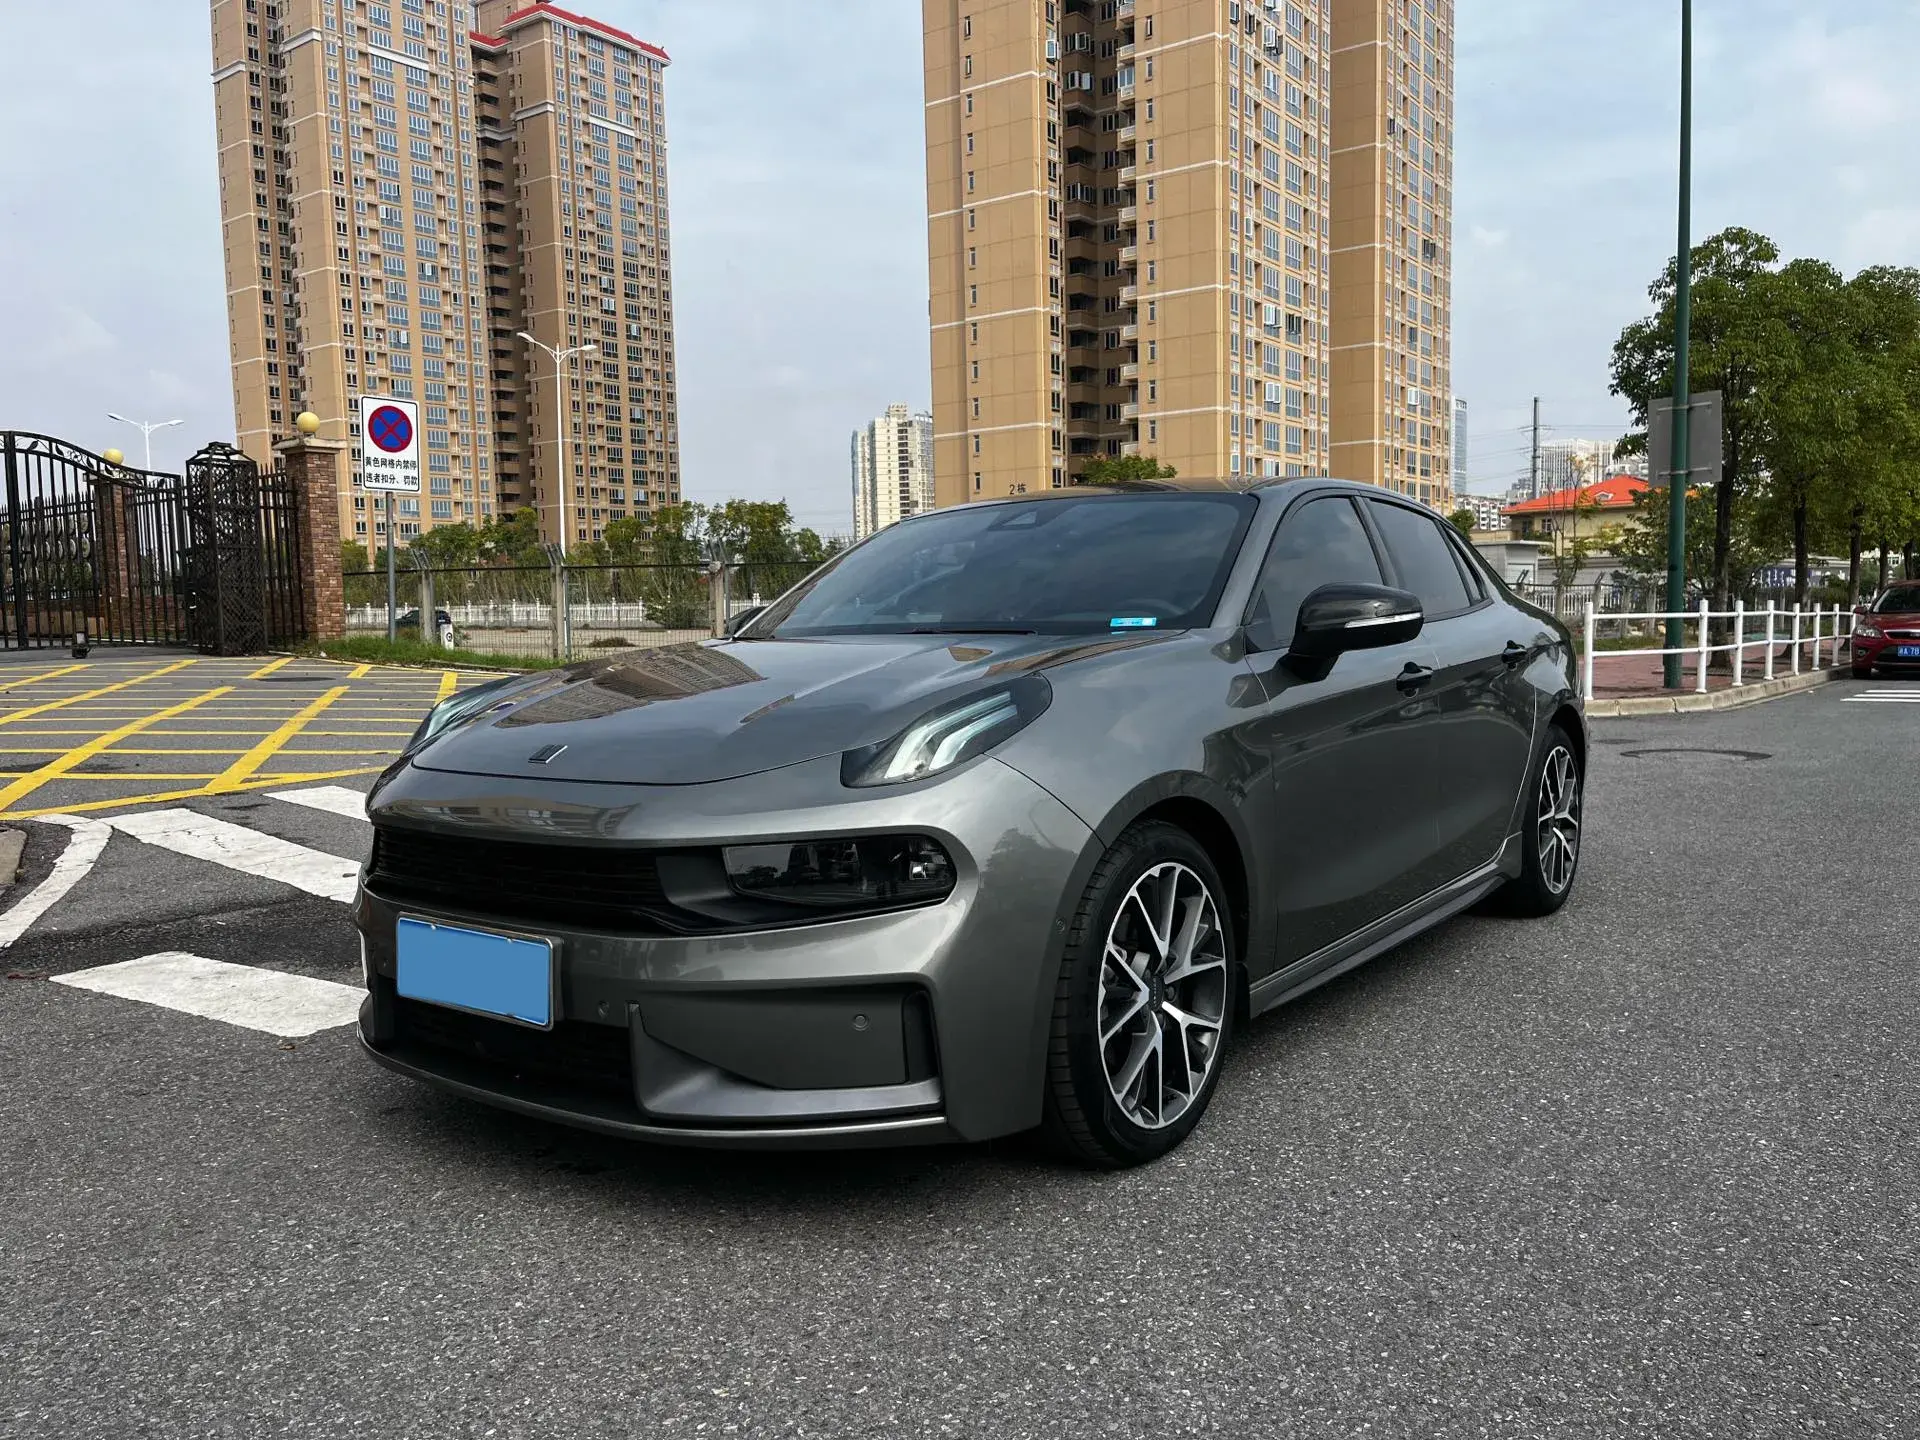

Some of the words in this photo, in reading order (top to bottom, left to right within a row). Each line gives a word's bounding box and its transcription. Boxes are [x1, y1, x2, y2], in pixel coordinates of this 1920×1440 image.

[365, 456, 417, 470] 黄色网格内禁停
[366, 472, 418, 486] 违者扣分、罚款
